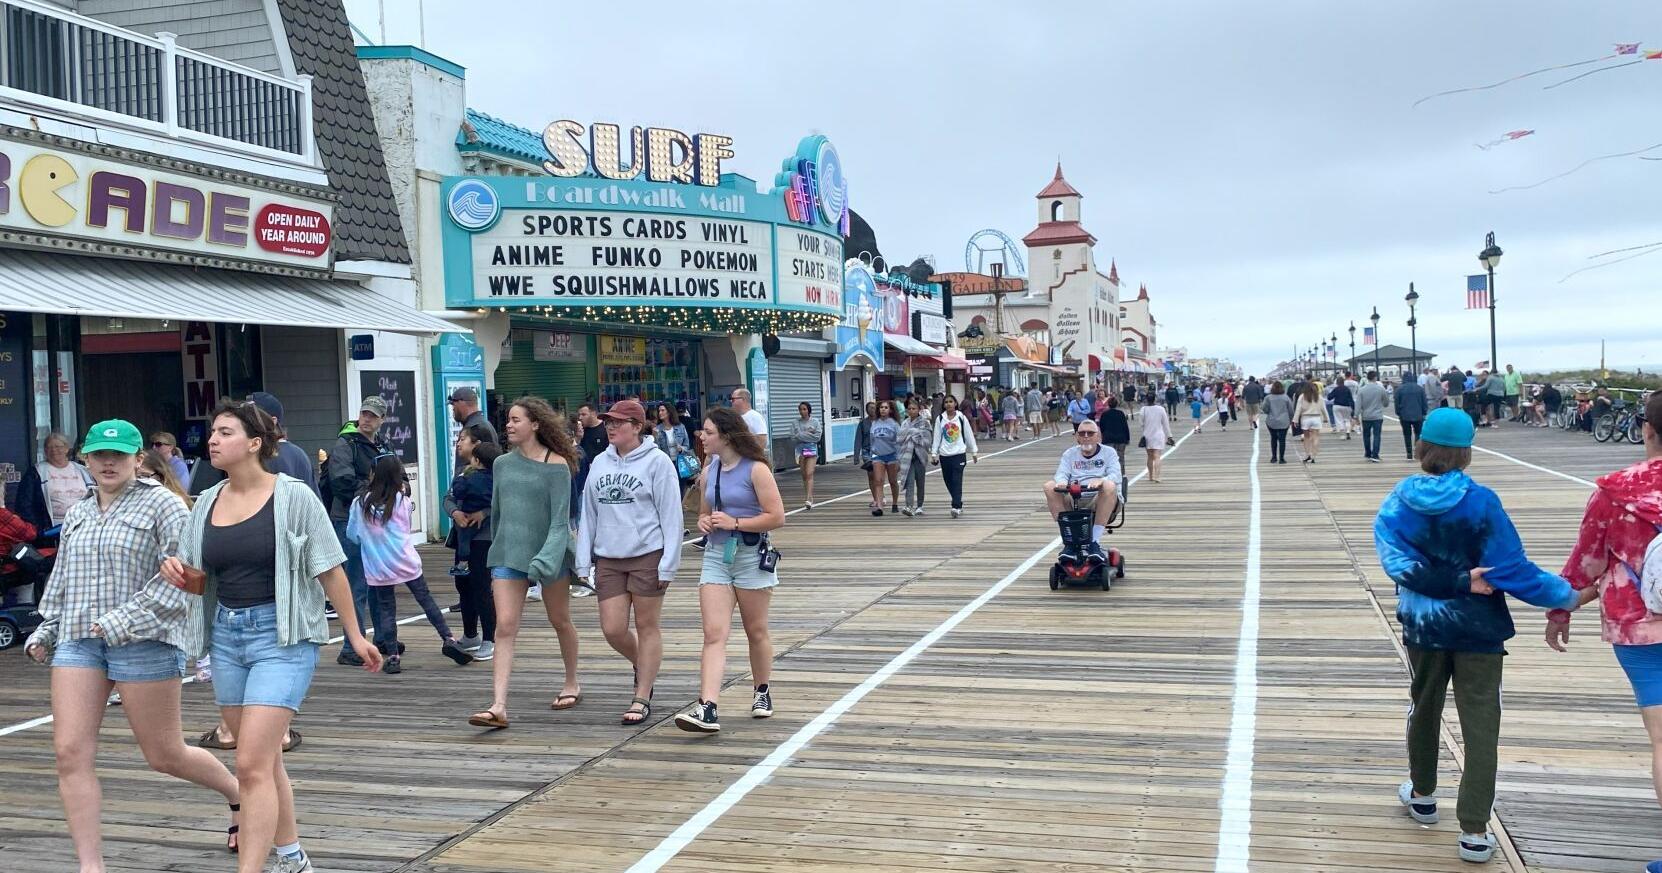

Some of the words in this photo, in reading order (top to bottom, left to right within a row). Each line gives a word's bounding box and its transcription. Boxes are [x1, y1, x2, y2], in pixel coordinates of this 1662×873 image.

[541, 119, 734, 187] SURF
[526, 182, 686, 209] Boardwalk
[699, 192, 745, 213] Mall
[268, 212, 293, 226] OPEN
[295, 214, 320, 228] DAILY
[522, 215, 612, 237] SPORTS
[622, 218, 687, 240] CARDS
[701, 222, 749, 244] VINYL
[261, 229, 285, 242] YEAR
[287, 230, 326, 245] AROUND
[797, 233, 820, 254] YOUR
[491, 245, 564, 266] ANIME
[592, 246, 661, 268] FUNKO
[681, 249, 757, 272] POKEMON
[793, 258, 825, 280] STARTS
[488, 275, 535, 296] WWE
[552, 275, 720, 298] SQUISHMALLOWS
[730, 279, 767, 300] NECA
[805, 286, 821, 304] NOW
[353, 343, 372, 352] ATM
[595, 472, 643, 492] VERMONT
